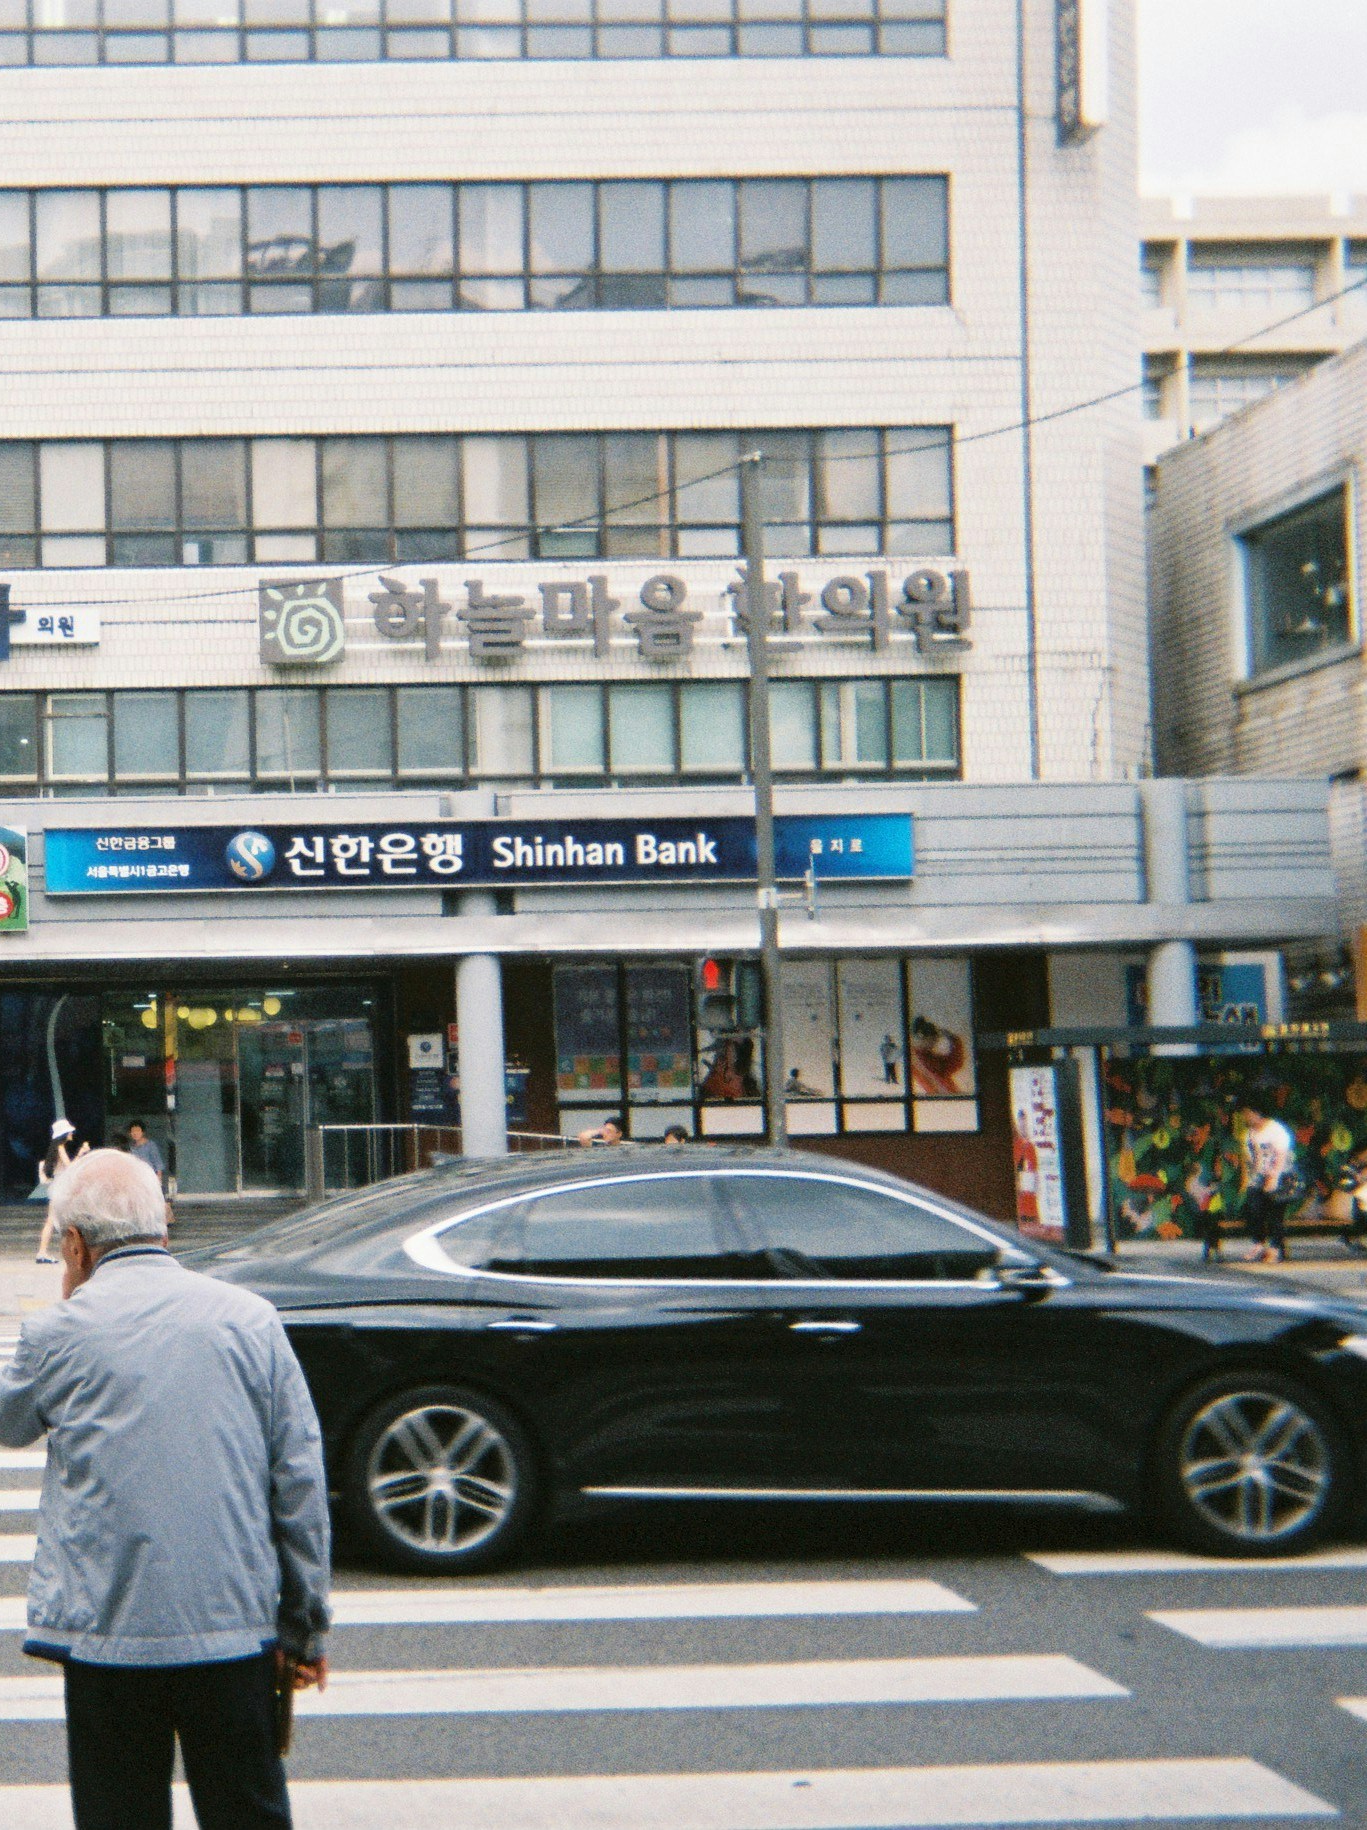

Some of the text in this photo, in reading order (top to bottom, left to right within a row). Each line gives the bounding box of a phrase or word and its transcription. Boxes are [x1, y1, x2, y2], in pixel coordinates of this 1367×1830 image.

[37, 615, 74, 638] 의원
[285, 833, 718, 876] 신한은행 Shinhan Bank
